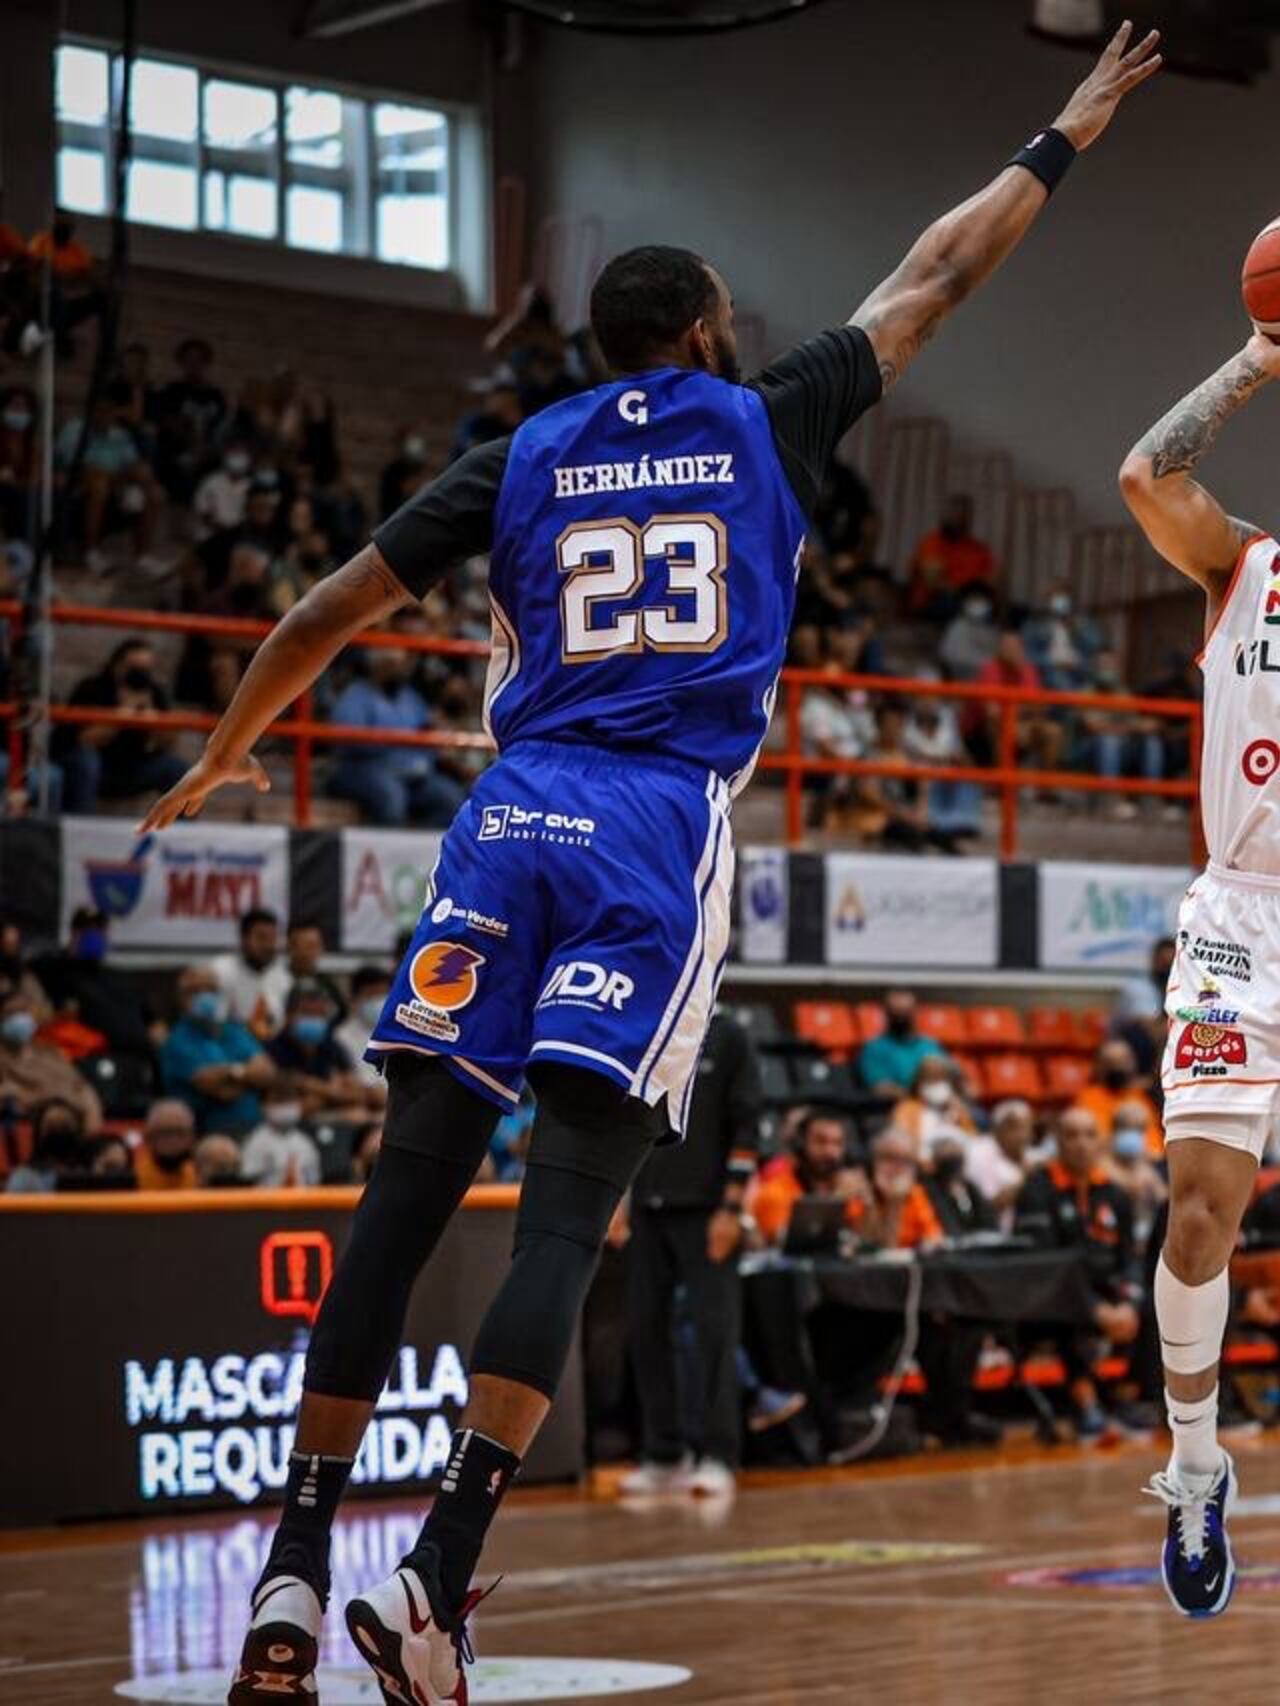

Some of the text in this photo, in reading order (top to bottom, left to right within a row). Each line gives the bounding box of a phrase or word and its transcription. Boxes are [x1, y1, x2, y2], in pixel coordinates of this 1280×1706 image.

[554, 454, 735, 498] HERNÁNDEZ
[555, 512, 729, 664] 23
[510, 805, 595, 833] brava
[124, 1343, 469, 1425] MASCALA
[139, 1414, 452, 1502] REQUIDA
